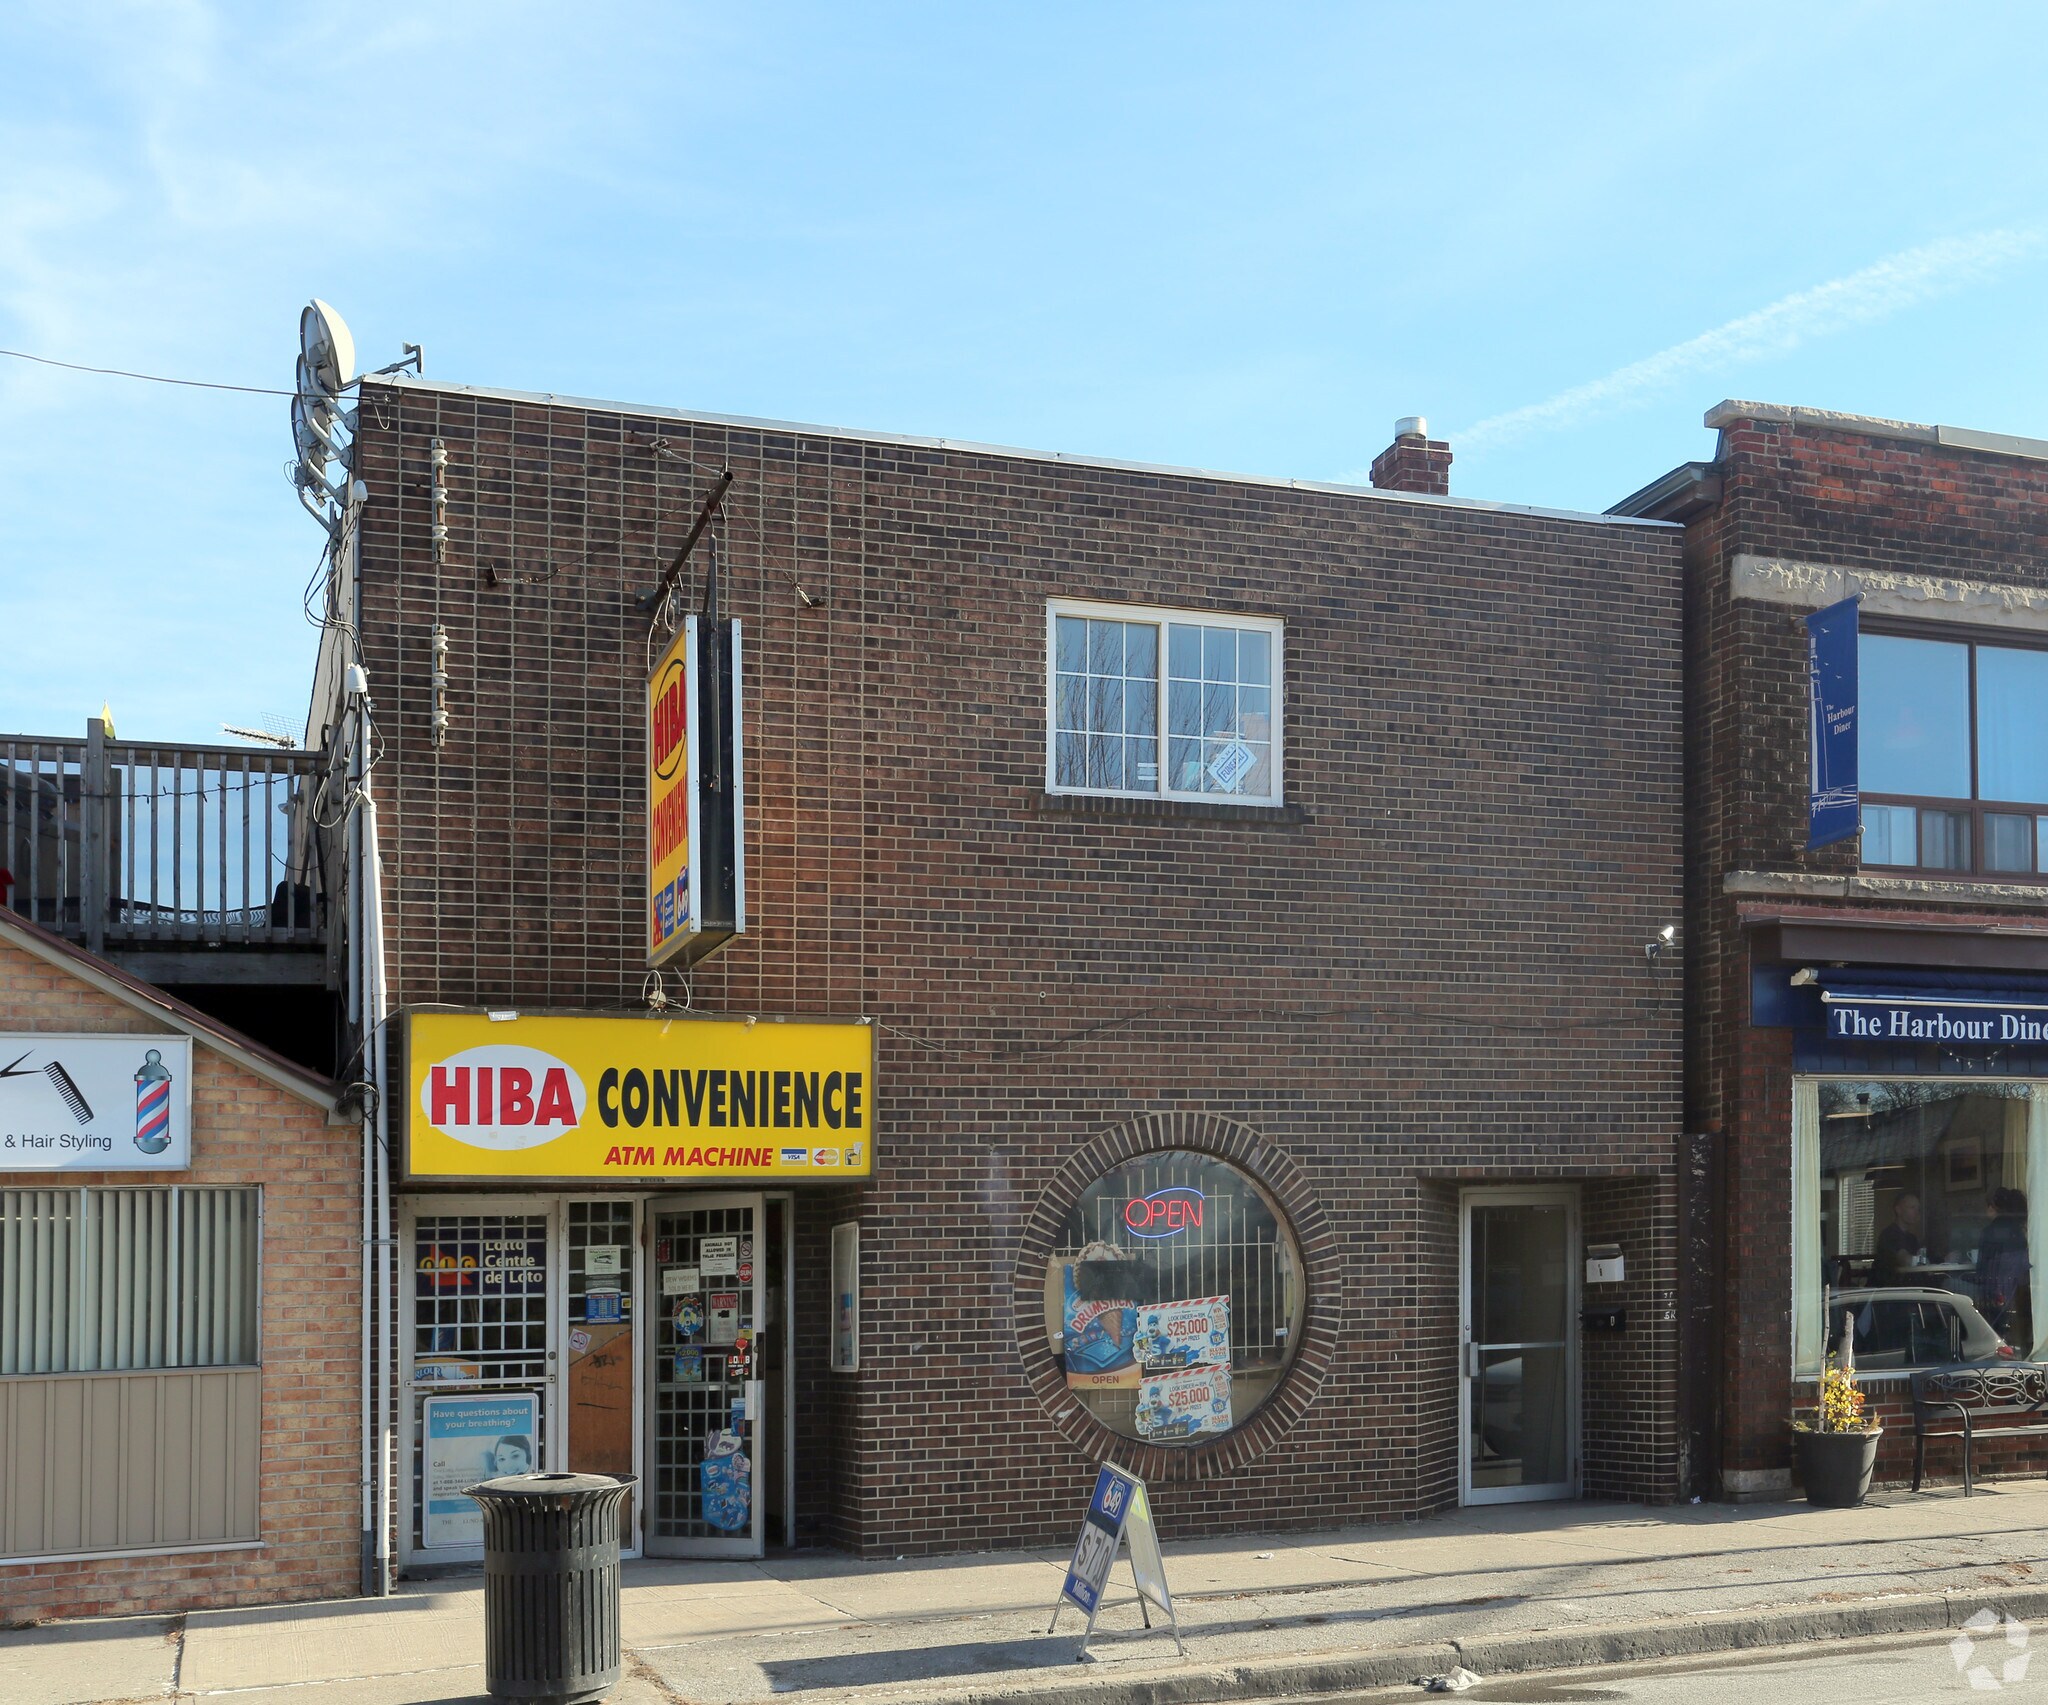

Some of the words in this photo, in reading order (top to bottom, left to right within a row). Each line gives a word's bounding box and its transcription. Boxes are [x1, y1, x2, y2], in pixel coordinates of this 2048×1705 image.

[652, 668, 687, 771] HIBA
[1827, 705, 1855, 723] Harbour
[1834, 721, 1851, 735] Diner
[1834, 1008, 1882, 1037] The
[1888, 1010, 1994, 1040] Harbour
[430, 1066, 579, 1128] HIBA
[597, 1067, 862, 1129] CONVENIENCE
[4, 1134, 16, 1148] &
[22, 1134, 55, 1148] Hair
[59, 1134, 112, 1151] Styling
[603, 1146, 655, 1167] ATM
[663, 1147, 773, 1167] MACHINE
[1125, 1198, 1203, 1227] OPEN
[484, 1254, 535, 1267] Centre
[485, 1271, 501, 1284] de
[509, 1271, 543, 1283] Loto
[712, 1296, 735, 1308] WARNING
[1092, 1376, 1119, 1384] OPEN
[433, 1410, 455, 1418] Have
[457, 1408, 500, 1419] questions
[502, 1407, 528, 1415] about
[445, 1421, 466, 1431] your
[468, 1418, 516, 1428] breathing?
